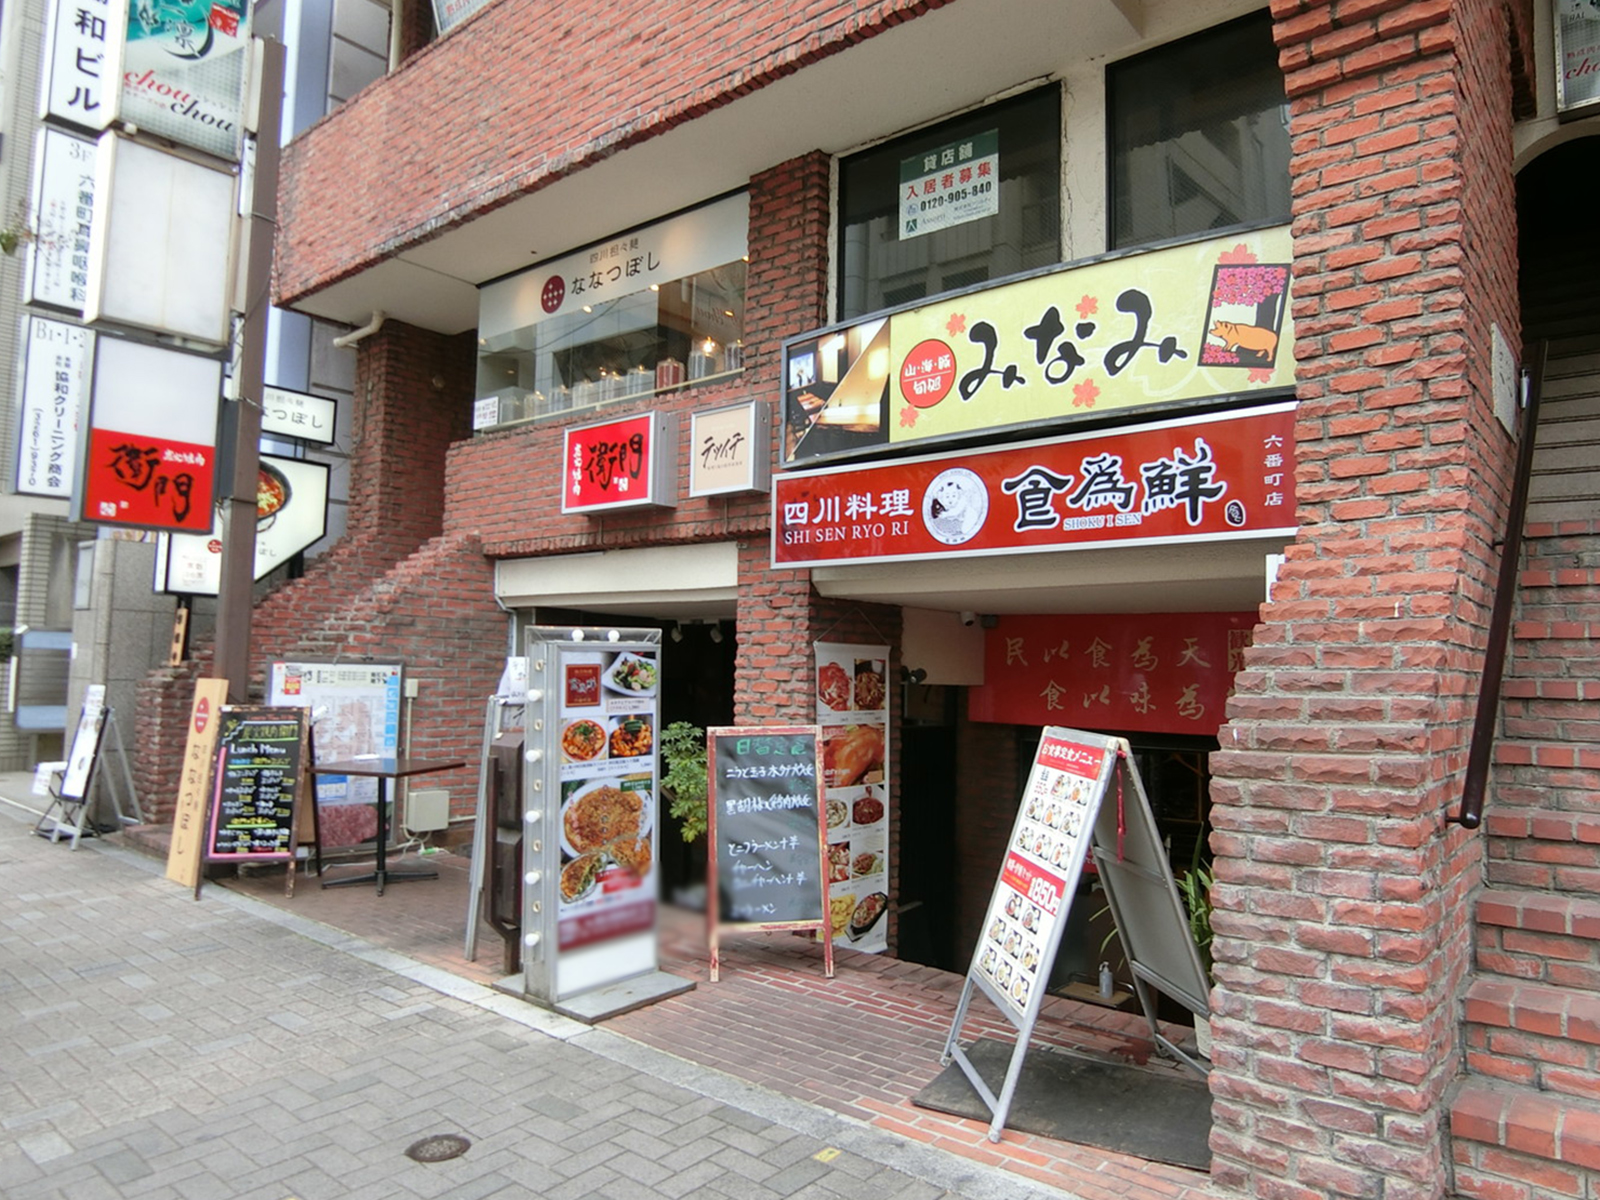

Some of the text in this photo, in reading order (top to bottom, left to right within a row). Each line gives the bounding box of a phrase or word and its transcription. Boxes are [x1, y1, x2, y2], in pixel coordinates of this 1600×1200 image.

[68, 0, 107, 111] 和ビル
[124, 69, 191, 103] chou
[170, 100, 234, 133] chou
[923, 142, 973, 173] 貸店舗
[906, 161, 992, 200] 入居者募集
[920, 181, 992, 211] 0120-905-840
[571, 251, 661, 295] ななつぼし
[959, 289, 1189, 402] みなみ
[1263, 434, 1284, 506] 六番町店
[784, 488, 915, 526] 四川料理
[1064, 512, 1142, 531] SHOKU I SEN
[784, 520, 909, 545] SHI SEN RYO RI
[1039, 679, 1236, 720] 食以味為
[230, 743, 286, 755] Lunch Menu
